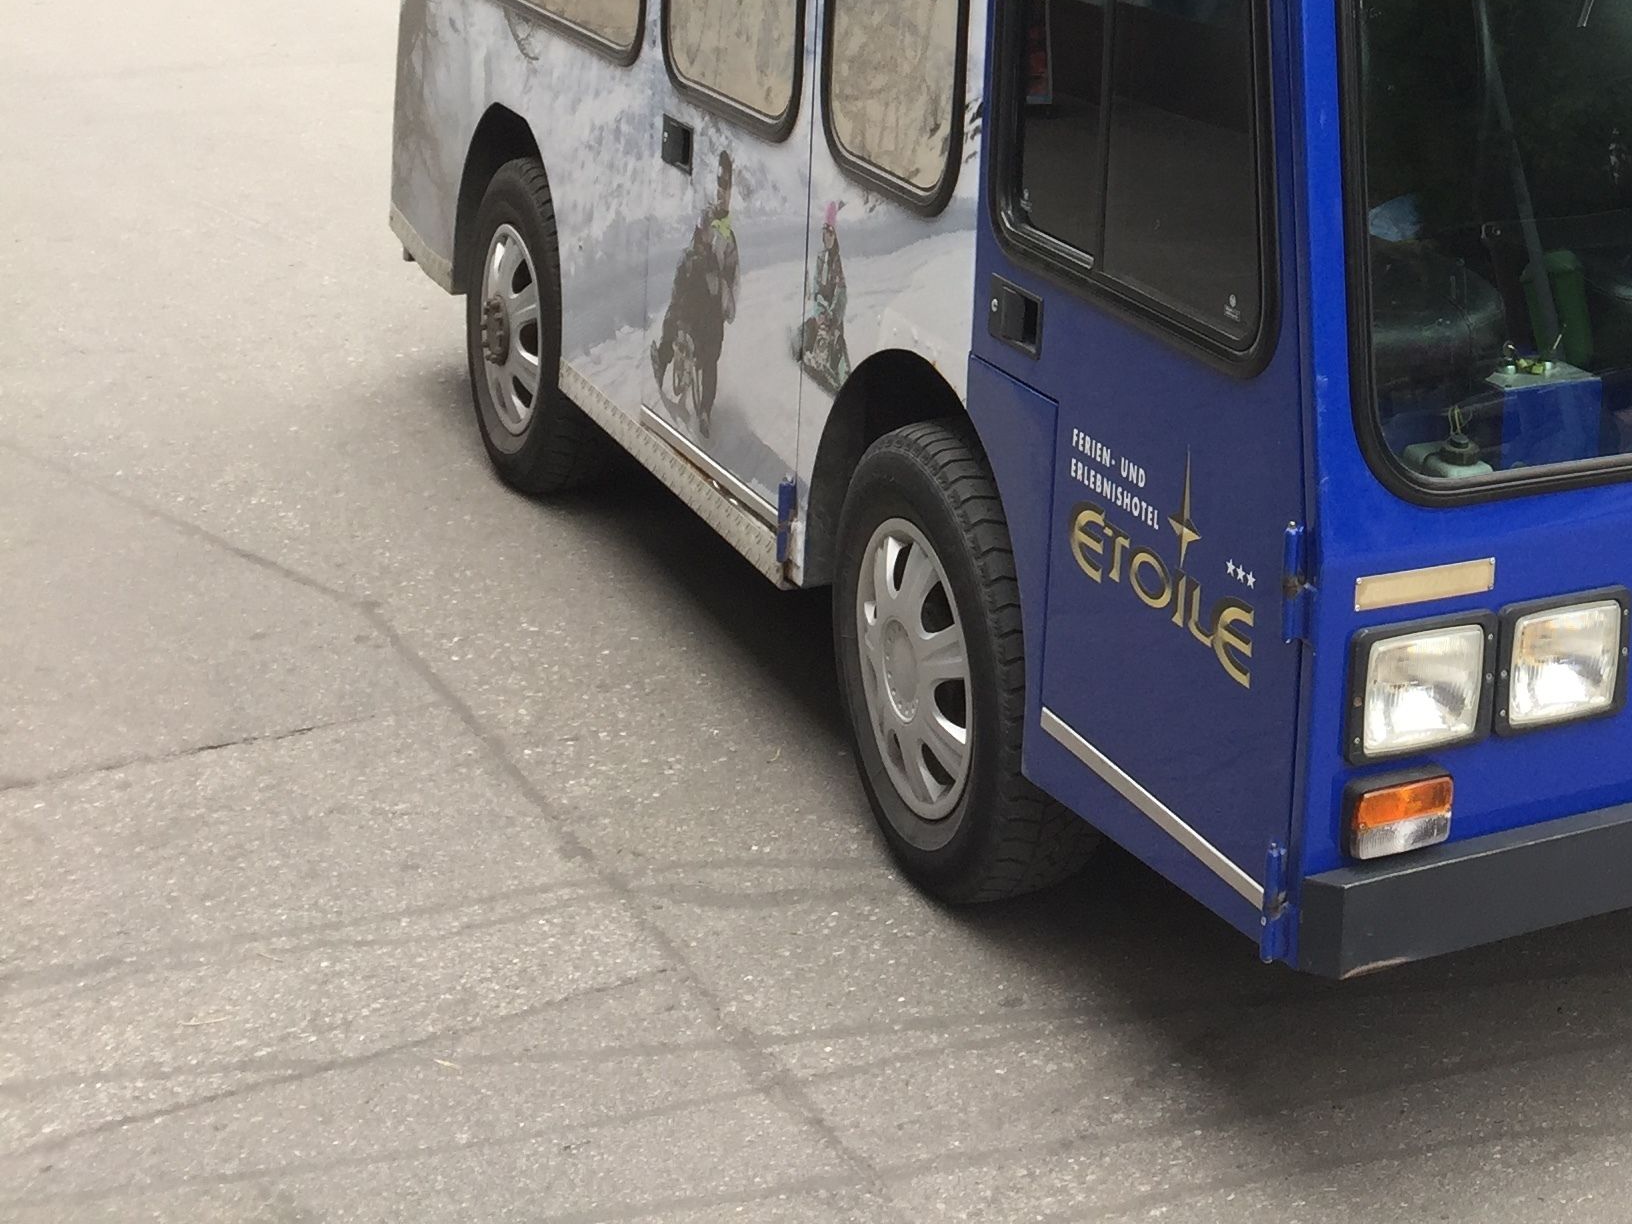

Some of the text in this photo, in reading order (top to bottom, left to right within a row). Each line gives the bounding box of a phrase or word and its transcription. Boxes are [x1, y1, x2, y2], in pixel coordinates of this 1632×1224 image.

[1072, 427, 1146, 488] FERIEN- UND
[1070, 458, 1159, 531] ERLEBNISHOTEL
[1070, 502, 1255, 689] ETOILE
